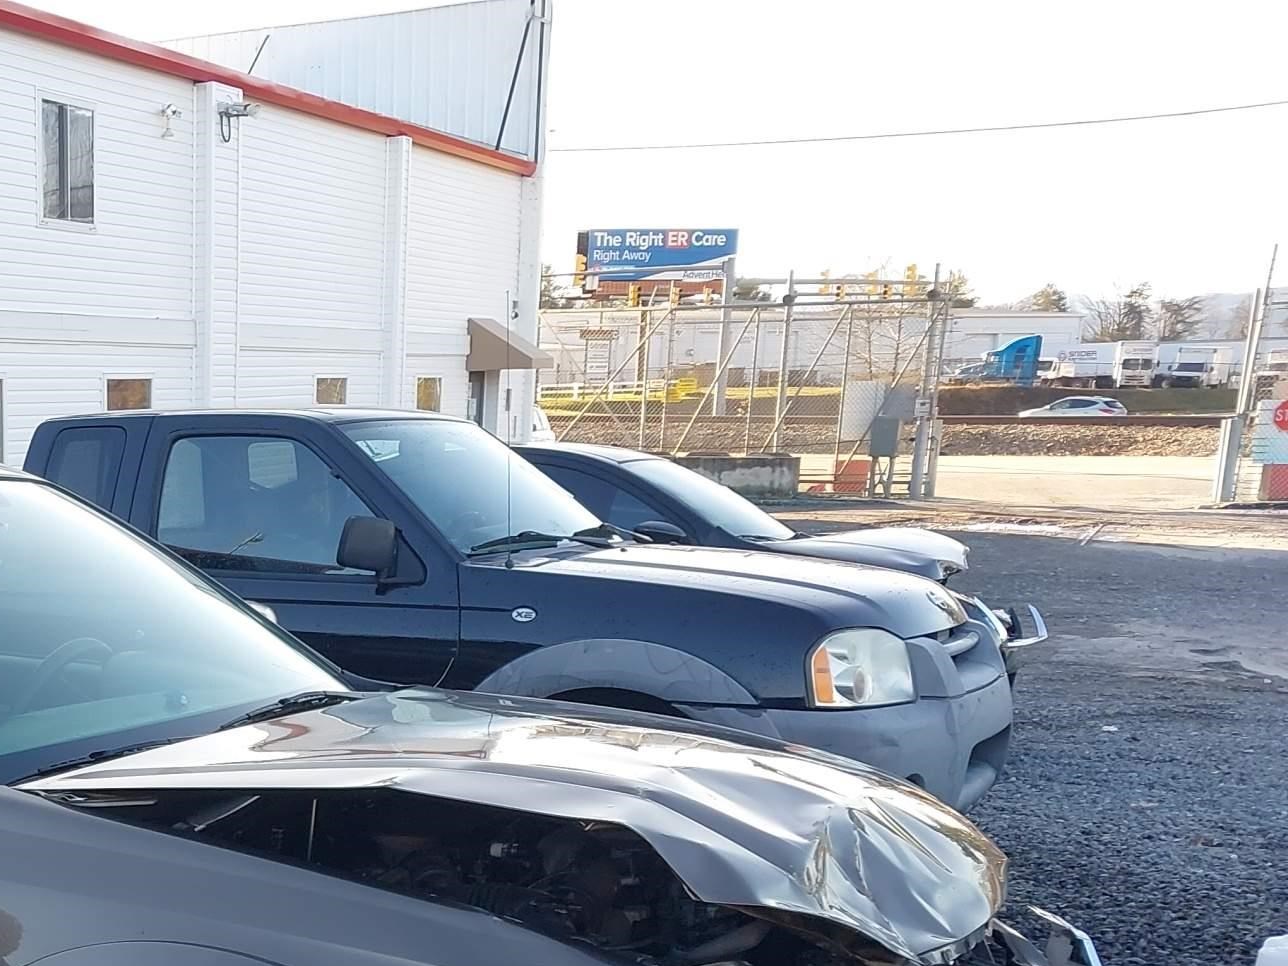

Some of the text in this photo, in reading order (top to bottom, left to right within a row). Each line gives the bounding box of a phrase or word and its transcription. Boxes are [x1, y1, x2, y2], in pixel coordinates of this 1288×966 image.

[594, 231, 727, 250] The Right ER Care
[593, 249, 652, 263] Right Away
